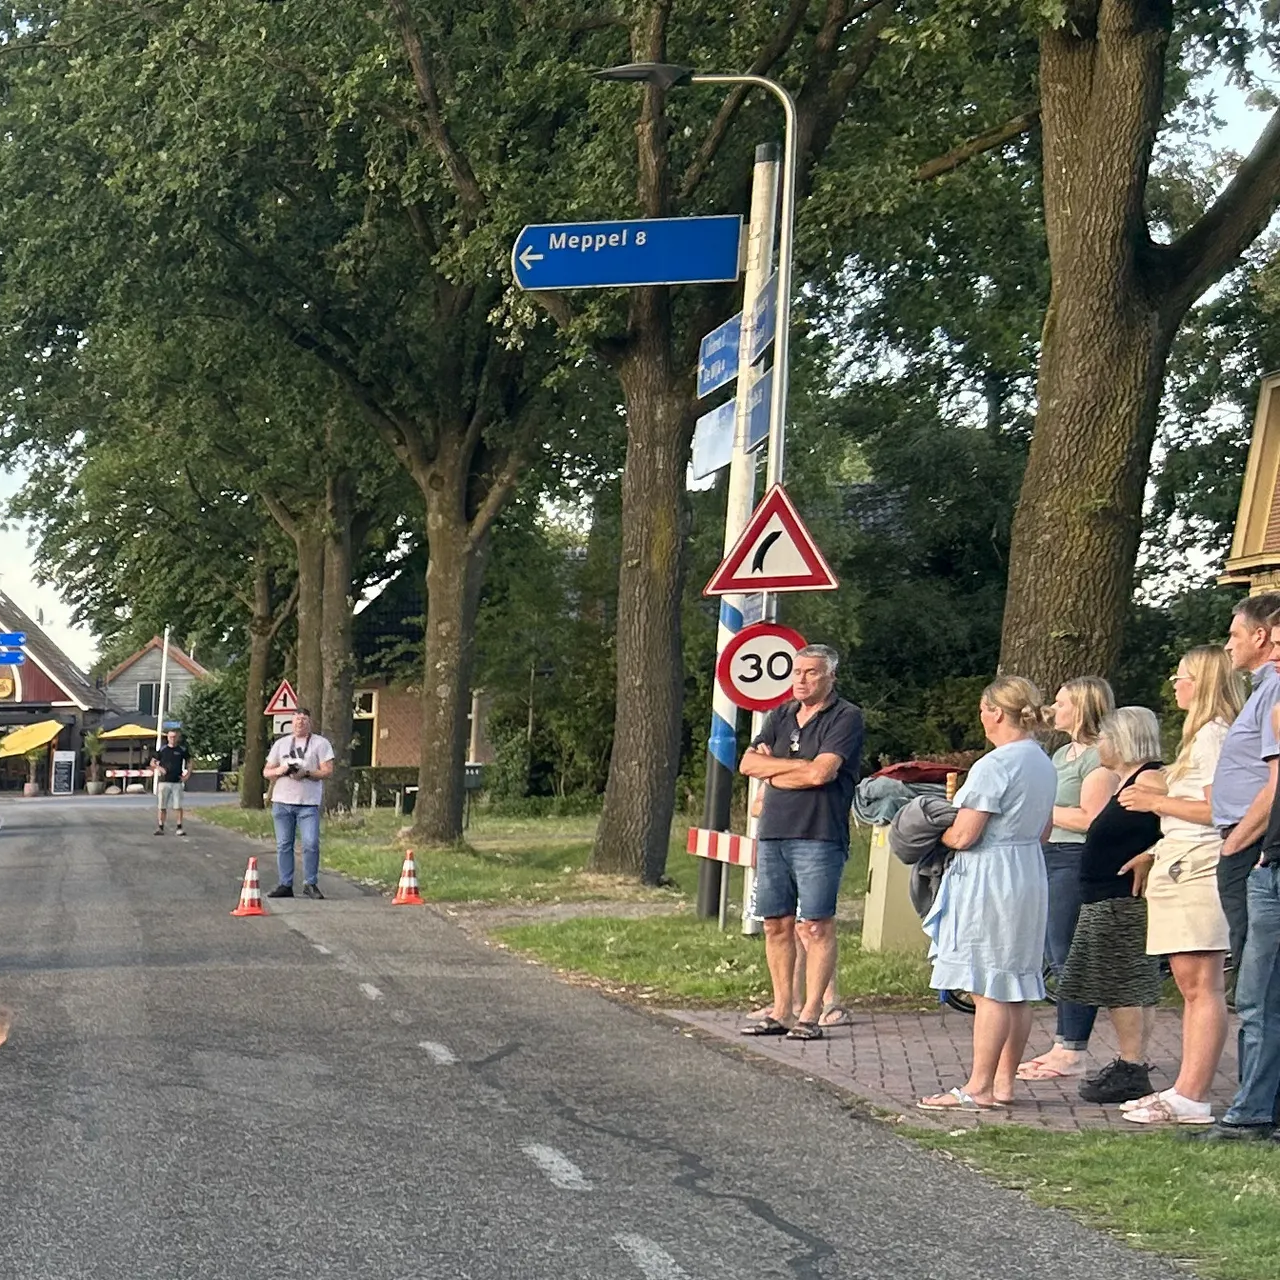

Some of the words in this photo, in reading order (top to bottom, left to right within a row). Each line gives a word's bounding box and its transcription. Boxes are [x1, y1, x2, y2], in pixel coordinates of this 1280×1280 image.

[548, 229, 627, 252] Meppel
[635, 230, 647, 246] 8
[738, 651, 793, 682] 30
